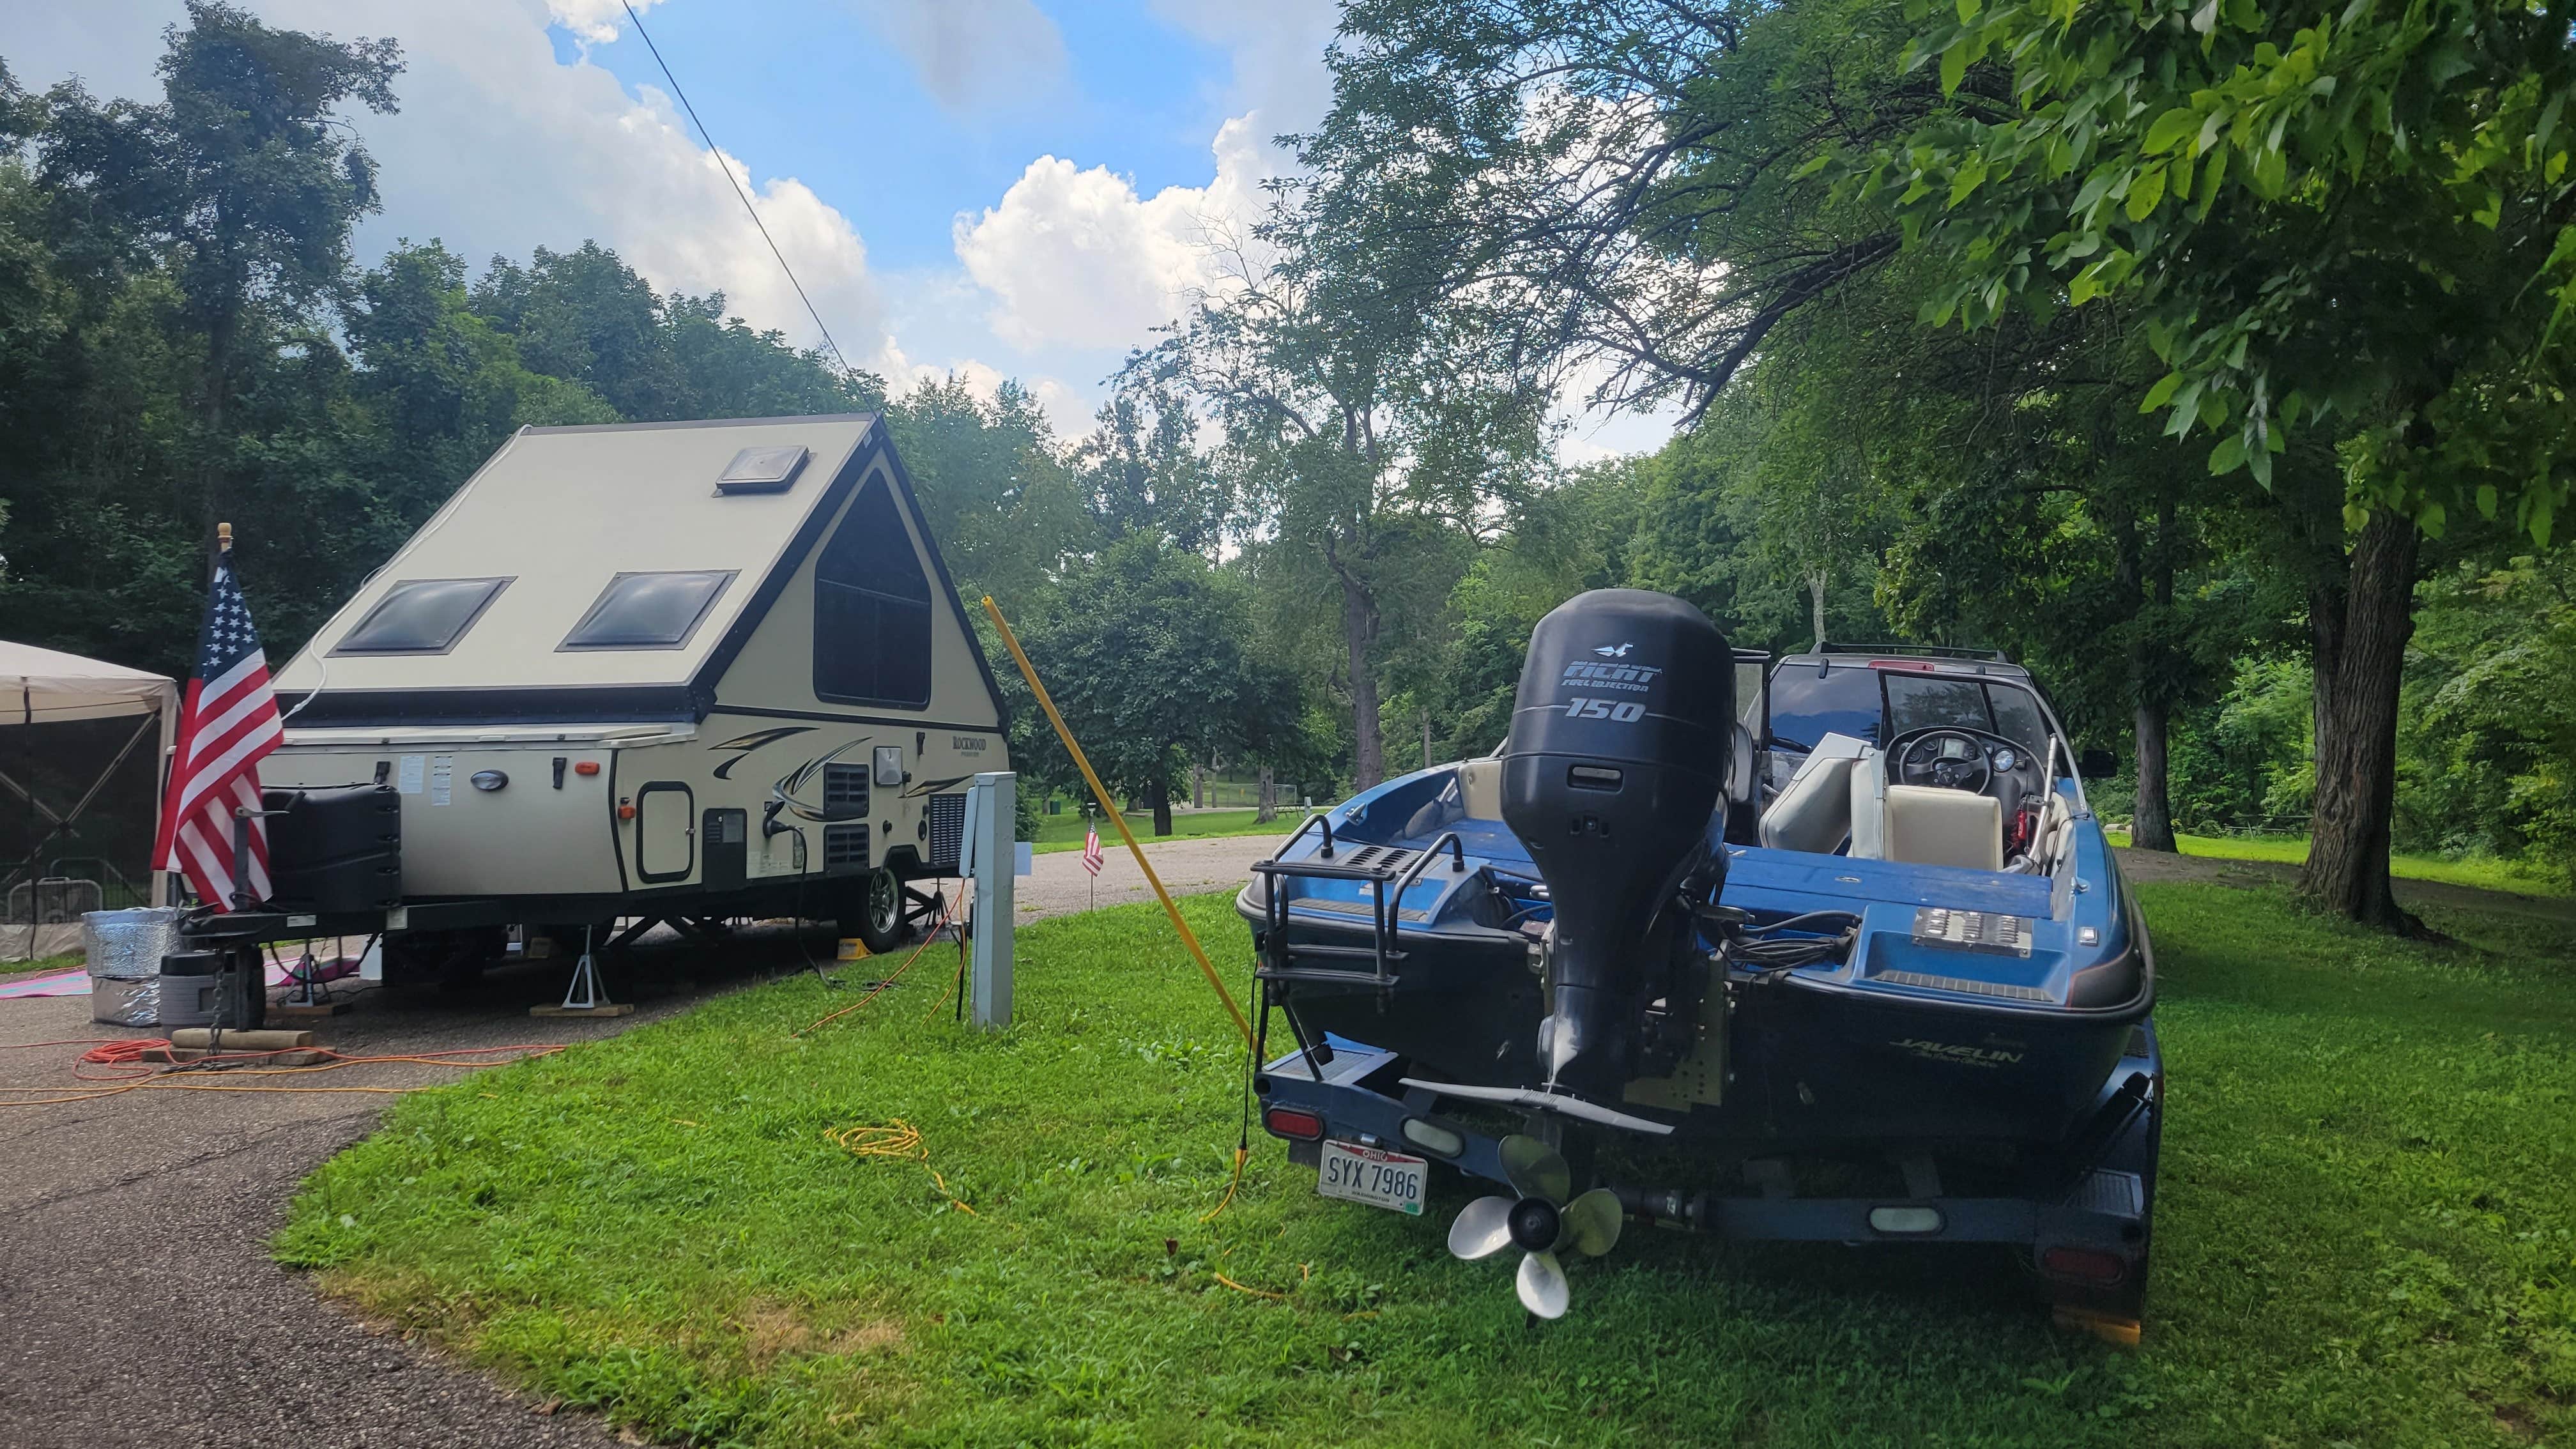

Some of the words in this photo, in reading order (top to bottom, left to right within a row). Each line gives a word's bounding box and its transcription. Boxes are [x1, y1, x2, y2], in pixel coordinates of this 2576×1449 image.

[1561, 678, 1590, 687] FUEL
[1589, 680, 1649, 693] INJECTION
[1565, 697, 1646, 723] 150
[952, 735, 986, 751] ROCKWOOD
[1889, 1038, 2025, 1063] JAVELIN
[1328, 1156, 1365, 1189] SYX
[1371, 1165, 1418, 1200] 7986
[1351, 1190, 1390, 1203] WASHINGTON
